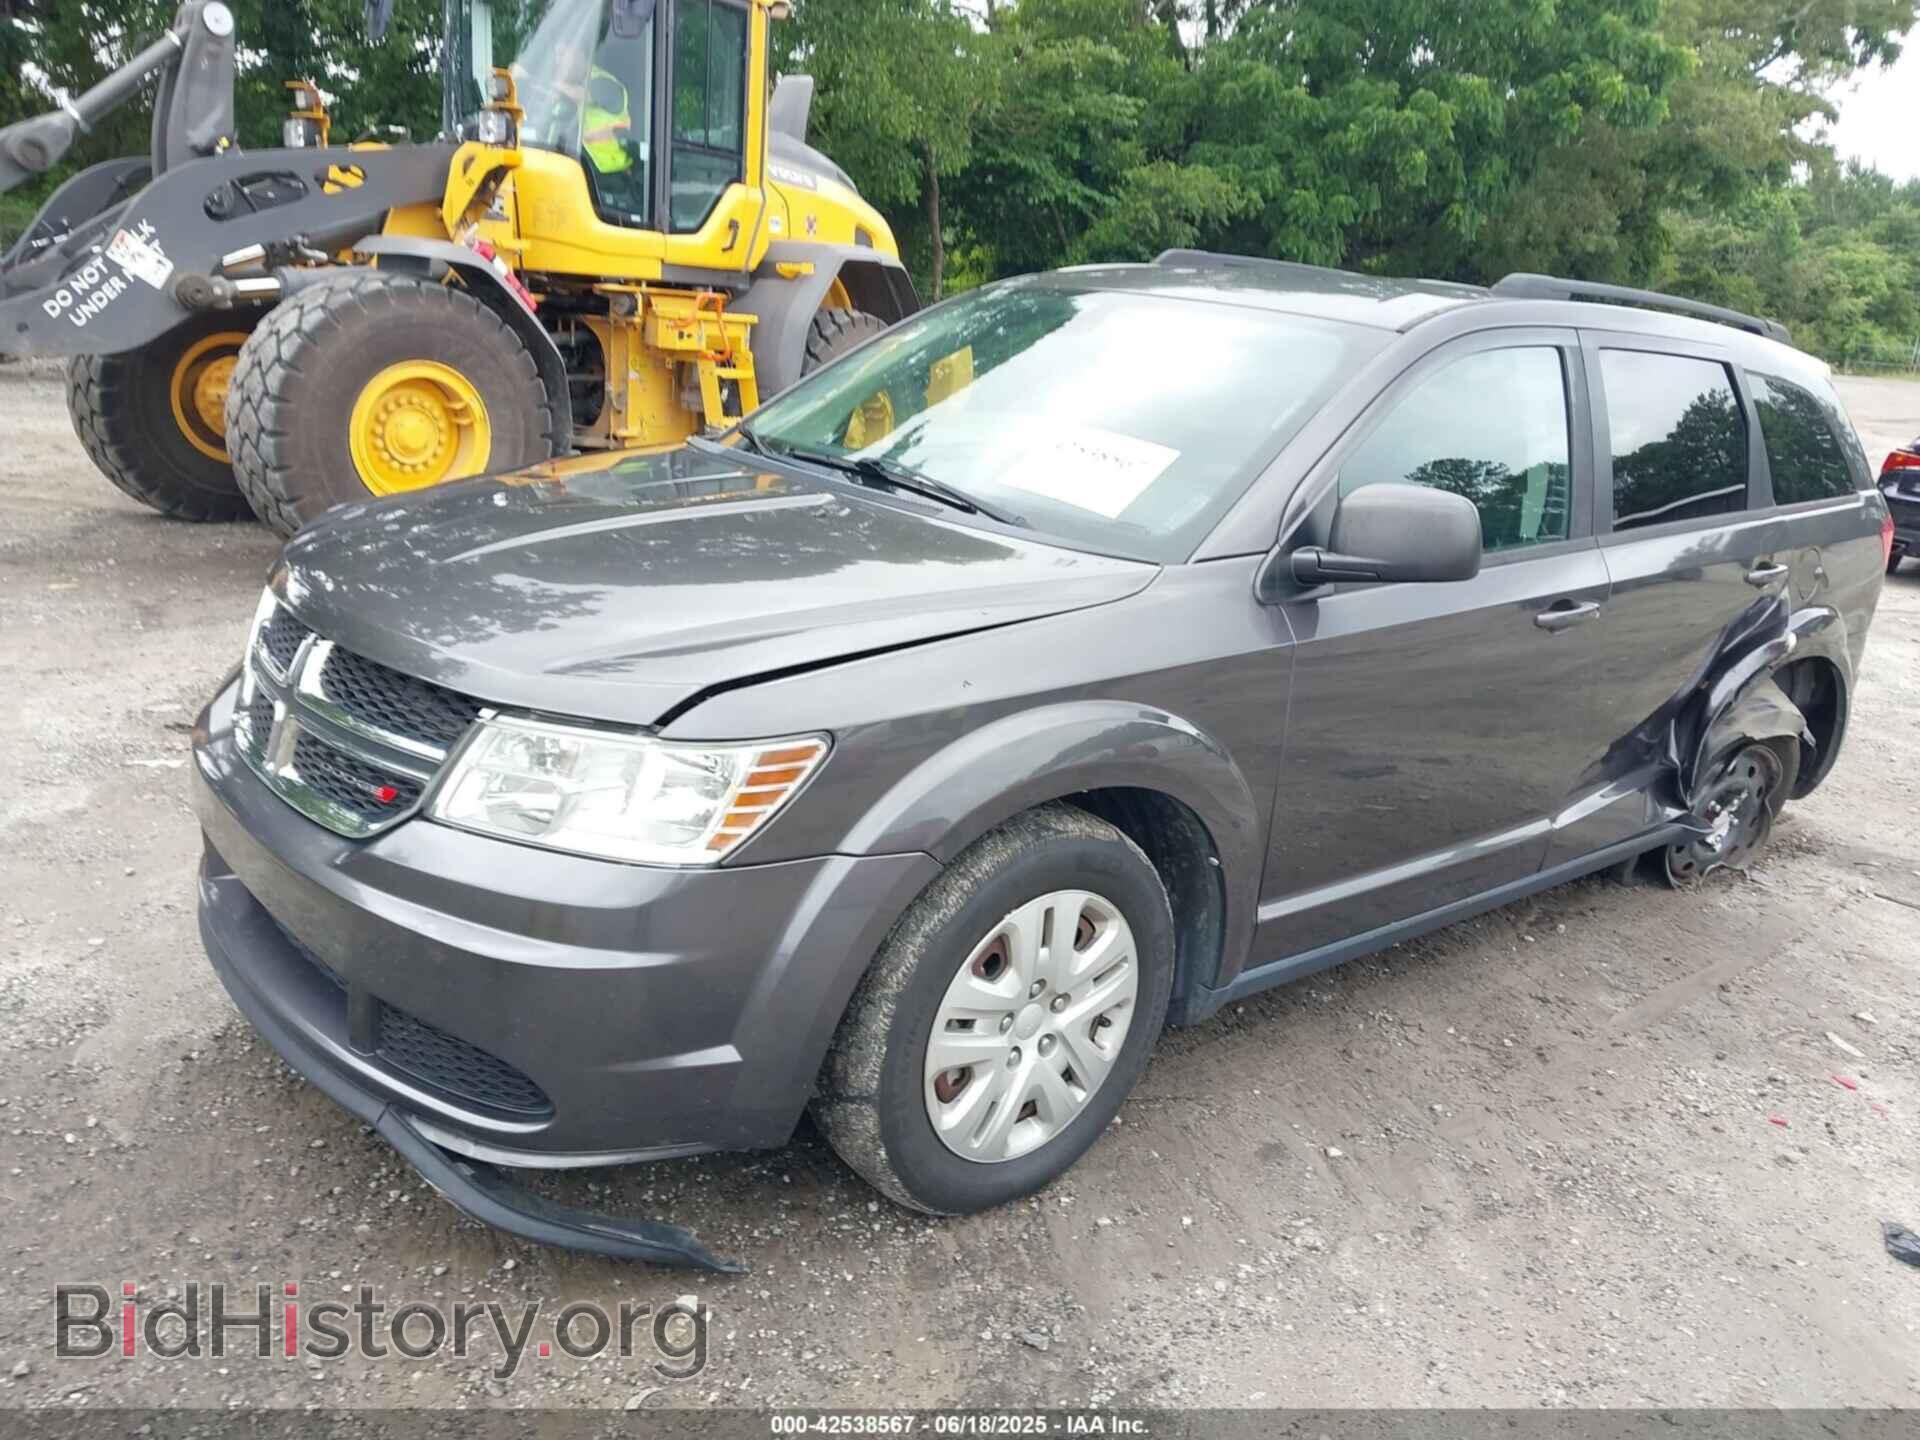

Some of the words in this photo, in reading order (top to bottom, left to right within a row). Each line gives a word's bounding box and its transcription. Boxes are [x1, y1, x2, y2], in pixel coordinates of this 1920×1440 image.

[42, 289, 73, 319] DO
[69, 255, 109, 296] NOT
[67, 275, 128, 327] UNDER
